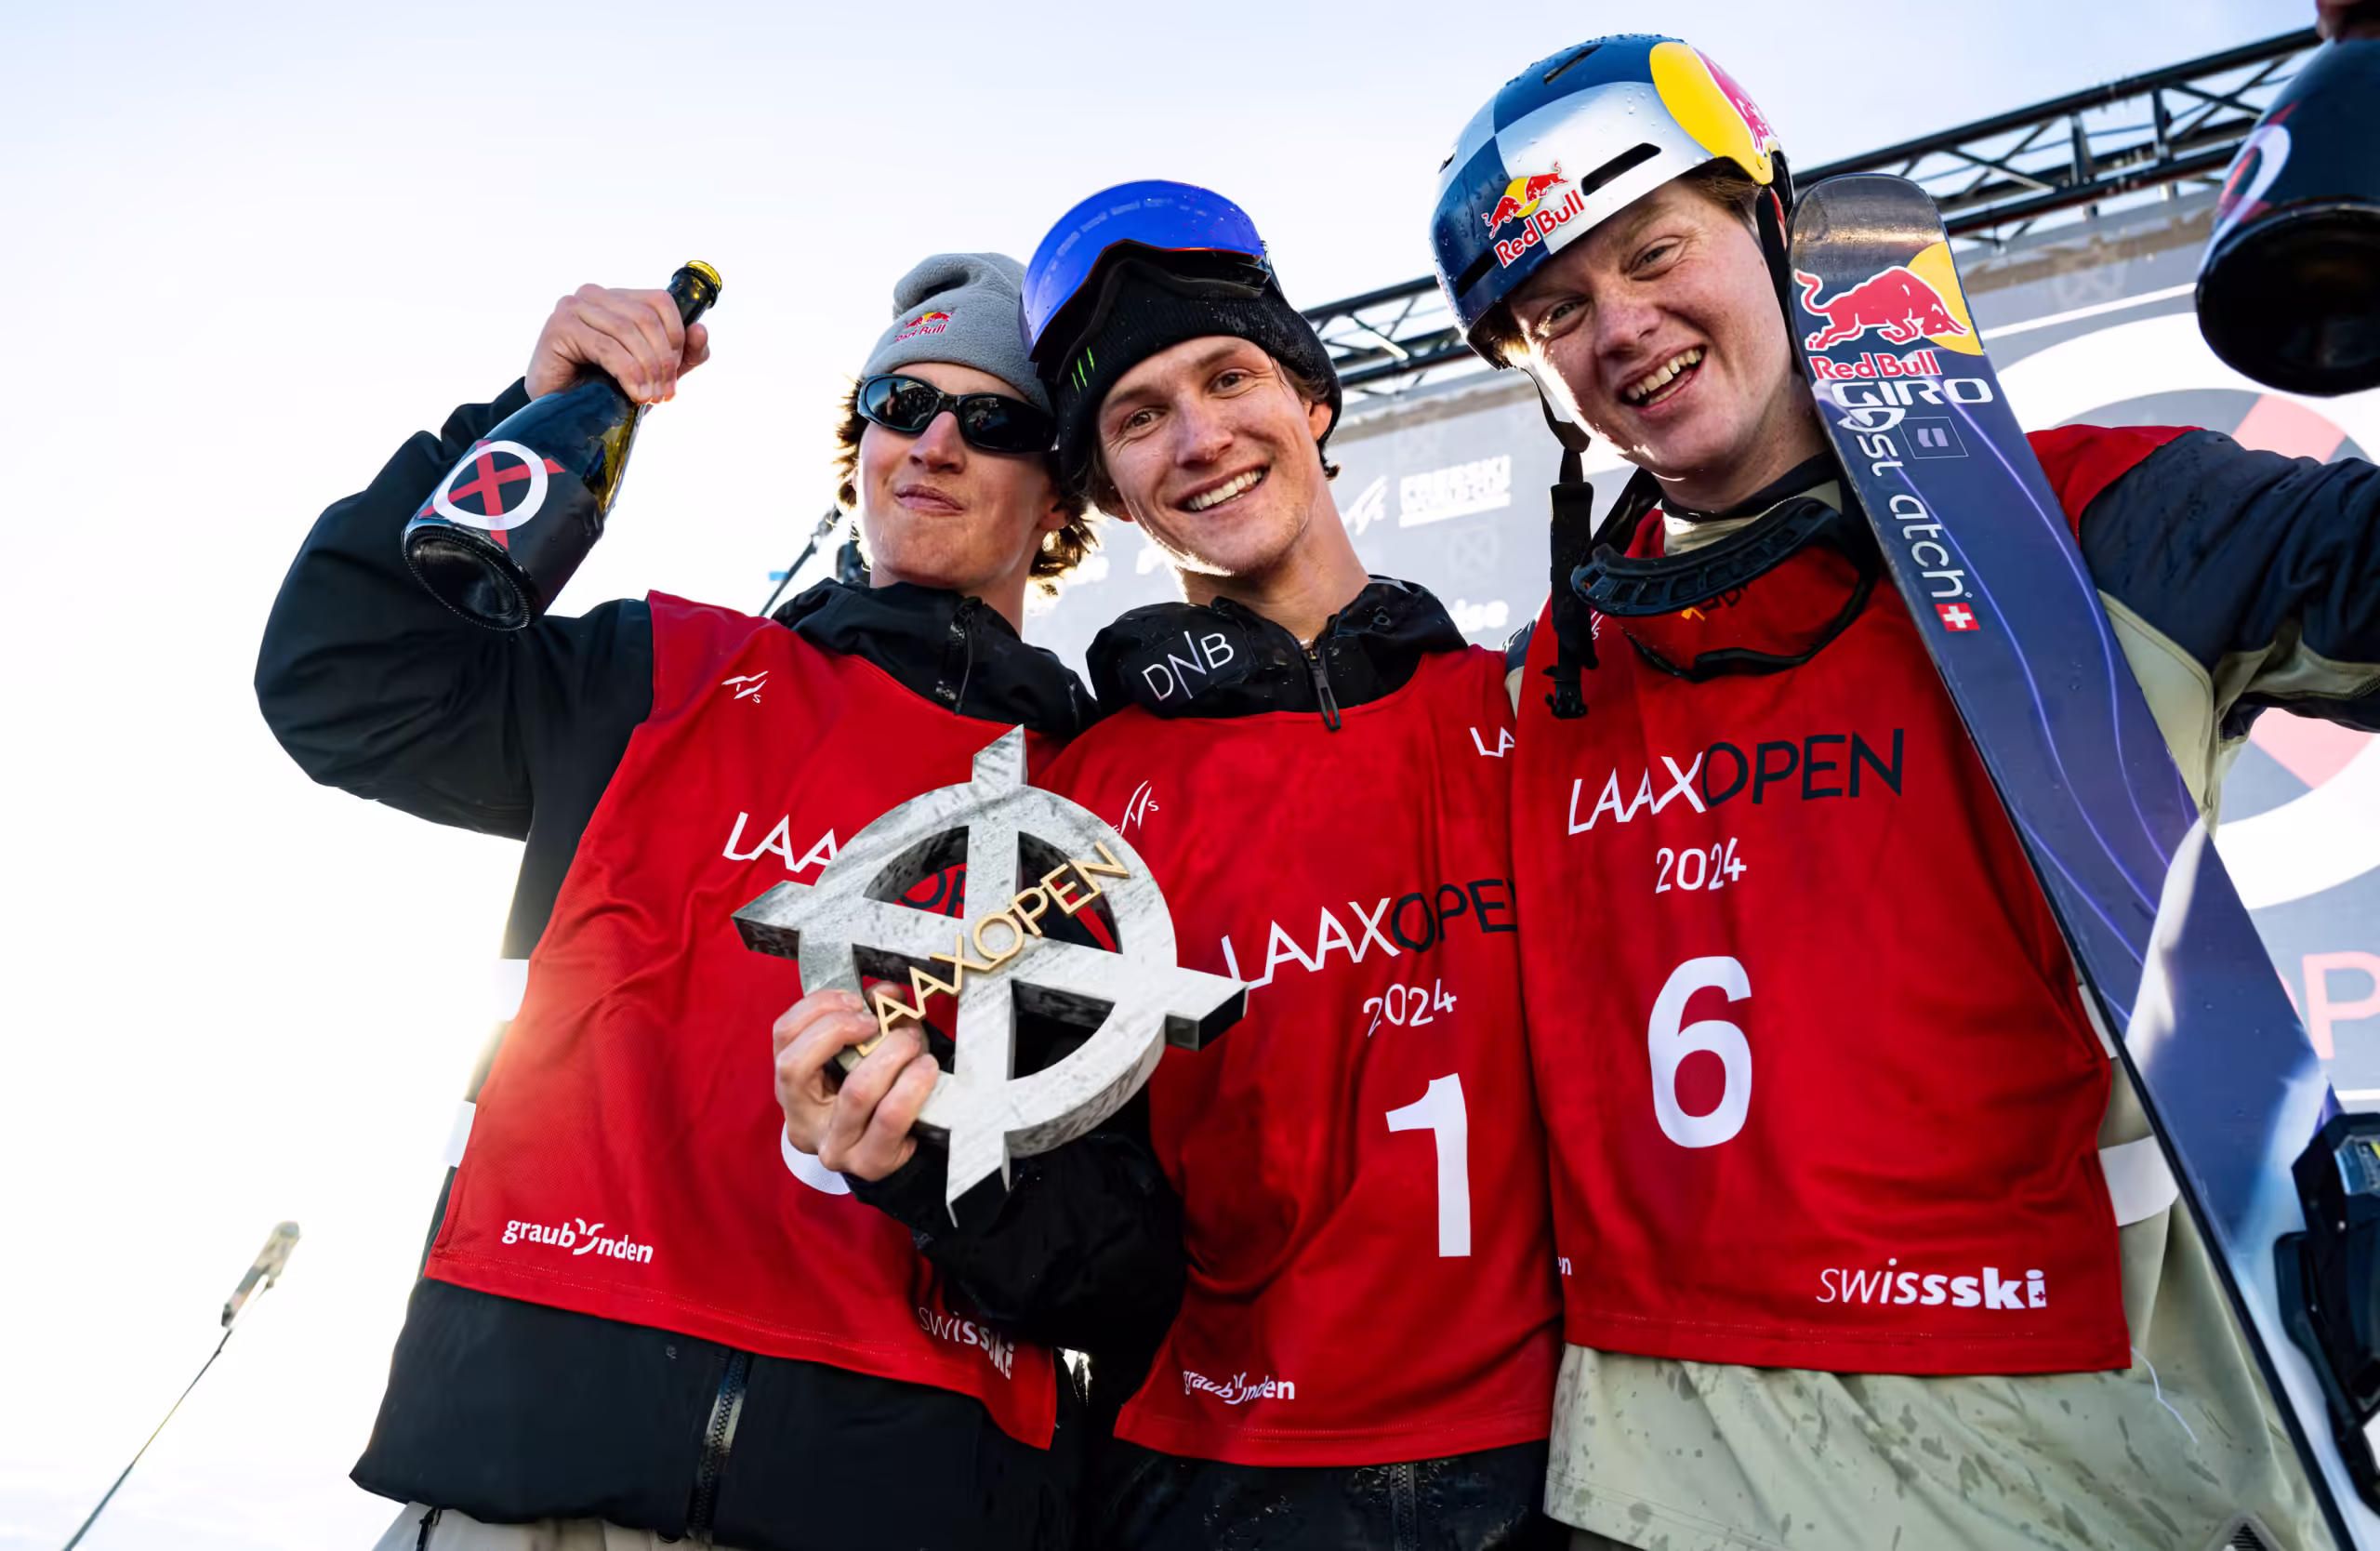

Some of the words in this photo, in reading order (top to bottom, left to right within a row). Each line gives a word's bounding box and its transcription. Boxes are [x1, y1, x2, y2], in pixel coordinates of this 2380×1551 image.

[1495, 225, 1540, 269] Red
[1534, 190, 1585, 238] Bull
[919, 324, 946, 335] Bull
[1809, 353, 1877, 380] Red
[1876, 350, 1942, 378] Bull
[1831, 378, 1993, 408] GIRO
[1142, 630, 1234, 702] DNB
[1655, 838, 1747, 894] 2024
[1363, 978, 1457, 1037] 2024
[1647, 955, 1752, 1148] 6
[1385, 1073, 1471, 1257] 1
